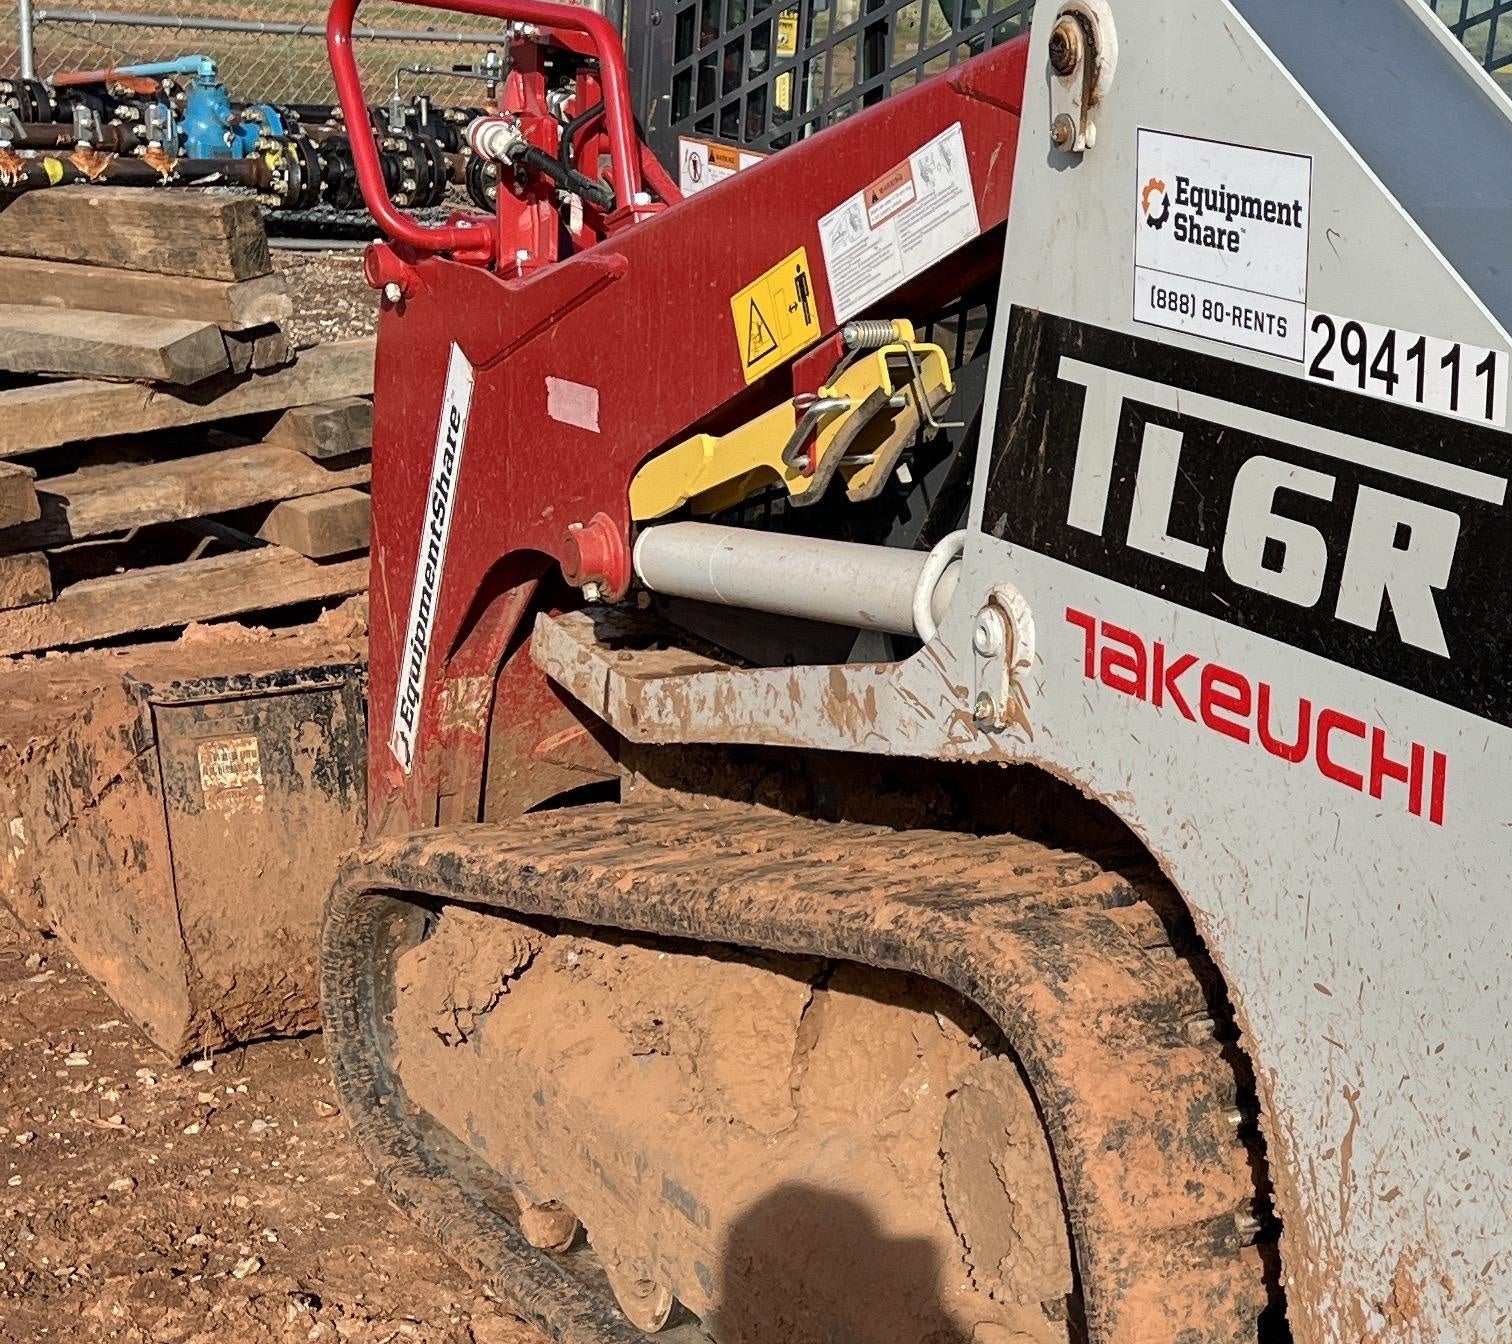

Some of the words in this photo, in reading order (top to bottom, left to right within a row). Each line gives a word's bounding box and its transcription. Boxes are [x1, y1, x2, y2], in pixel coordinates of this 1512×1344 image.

[1173, 175, 1303, 229] Equipment
[1173, 212, 1241, 254] Share
[1149, 284, 1197, 319] (888)
[1201, 299, 1288, 339] 80-RENTS
[1308, 312, 1498, 422] 294111
[1056, 355, 1509, 660] TL6R
[399, 403, 463, 734] EquipmentShare
[1064, 606, 1448, 828] TAKEUCHI
